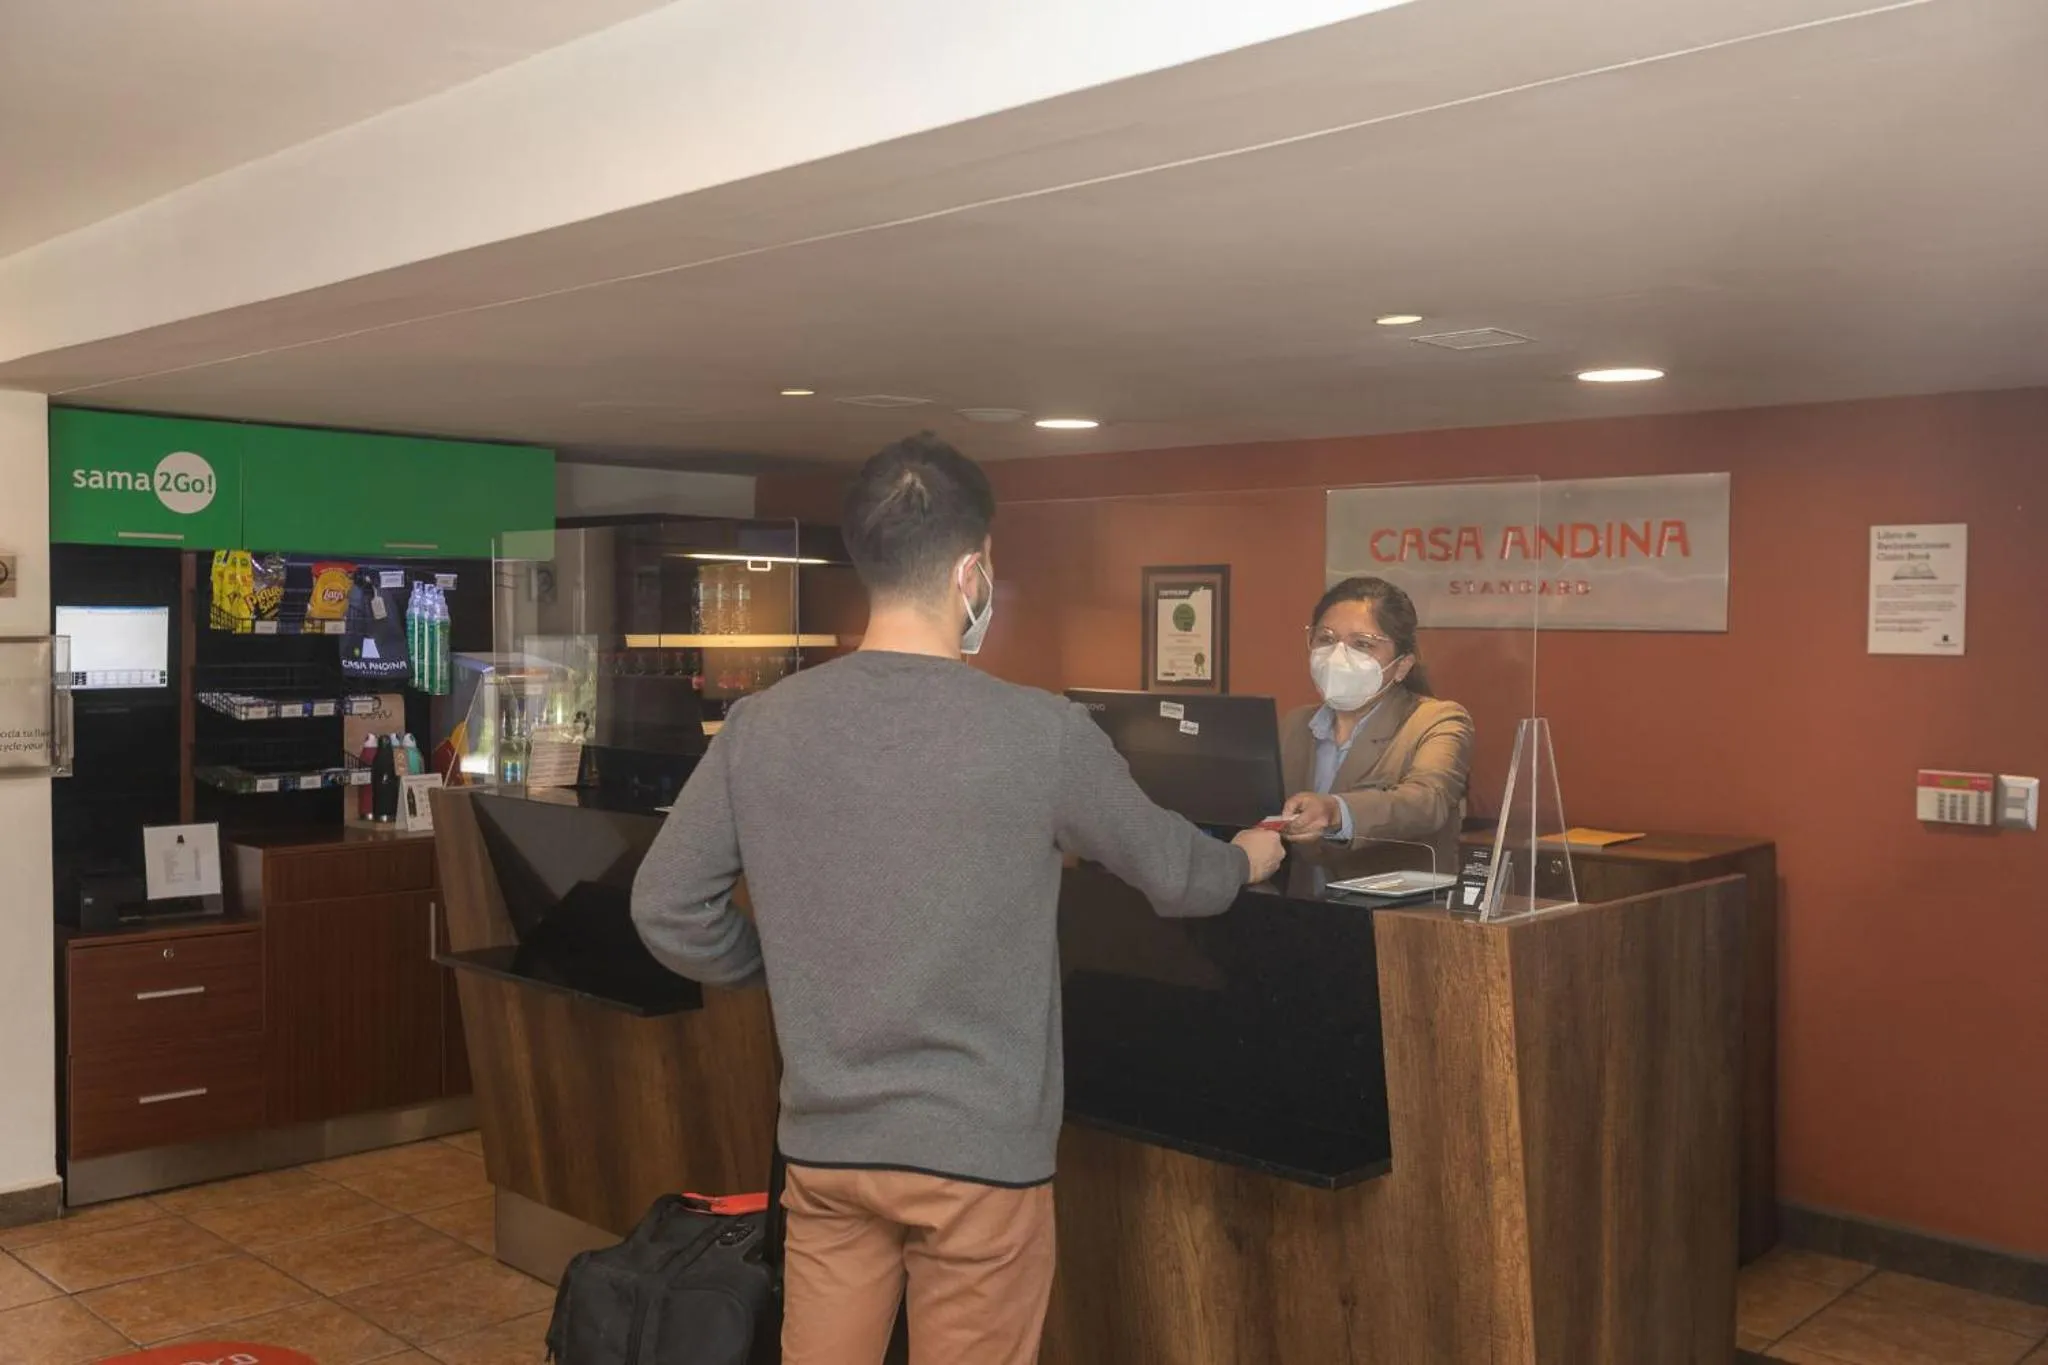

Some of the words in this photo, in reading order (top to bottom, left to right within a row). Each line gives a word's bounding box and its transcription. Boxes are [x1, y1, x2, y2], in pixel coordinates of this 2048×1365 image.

[72, 468, 151, 492] sama
[159, 471, 213, 495] 2Go!
[1370, 526, 1483, 562] CASA
[1500, 520, 1690, 560] ANDINA
[1449, 580, 1592, 595] STANDARD
[342, 659, 367, 670] CASA
